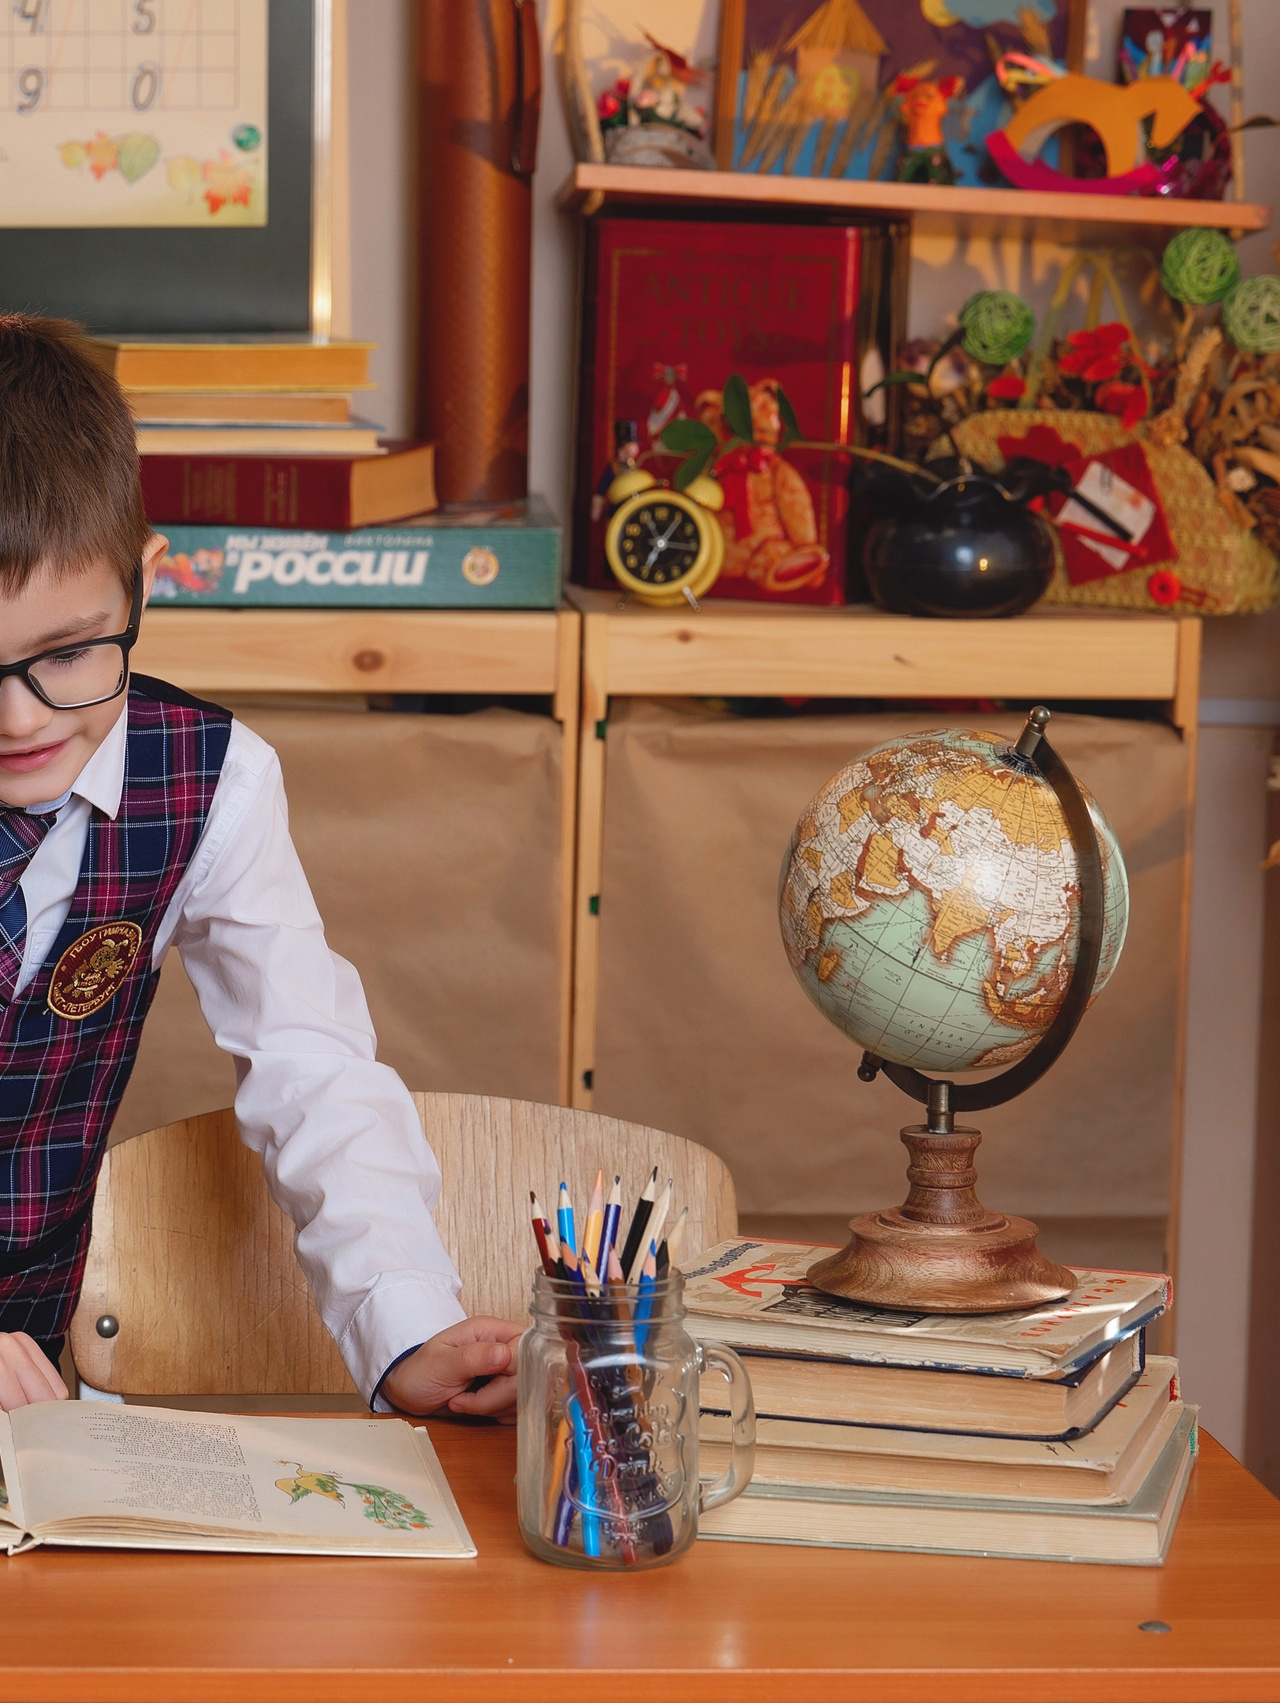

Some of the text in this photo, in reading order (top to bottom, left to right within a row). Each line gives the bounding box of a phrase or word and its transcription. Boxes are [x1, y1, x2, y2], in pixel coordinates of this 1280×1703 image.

[132, 0, 156, 35] 5
[17, 63, 159, 115] 9 0
[639, 271, 808, 313] ANTIQUE
[672, 314, 768, 353] TOYS
[343, 534, 434, 548] ВИКТОРИНА
[69, 933, 97, 958] ГБОУ
[909, 1019, 966, 1042] INDIAN
